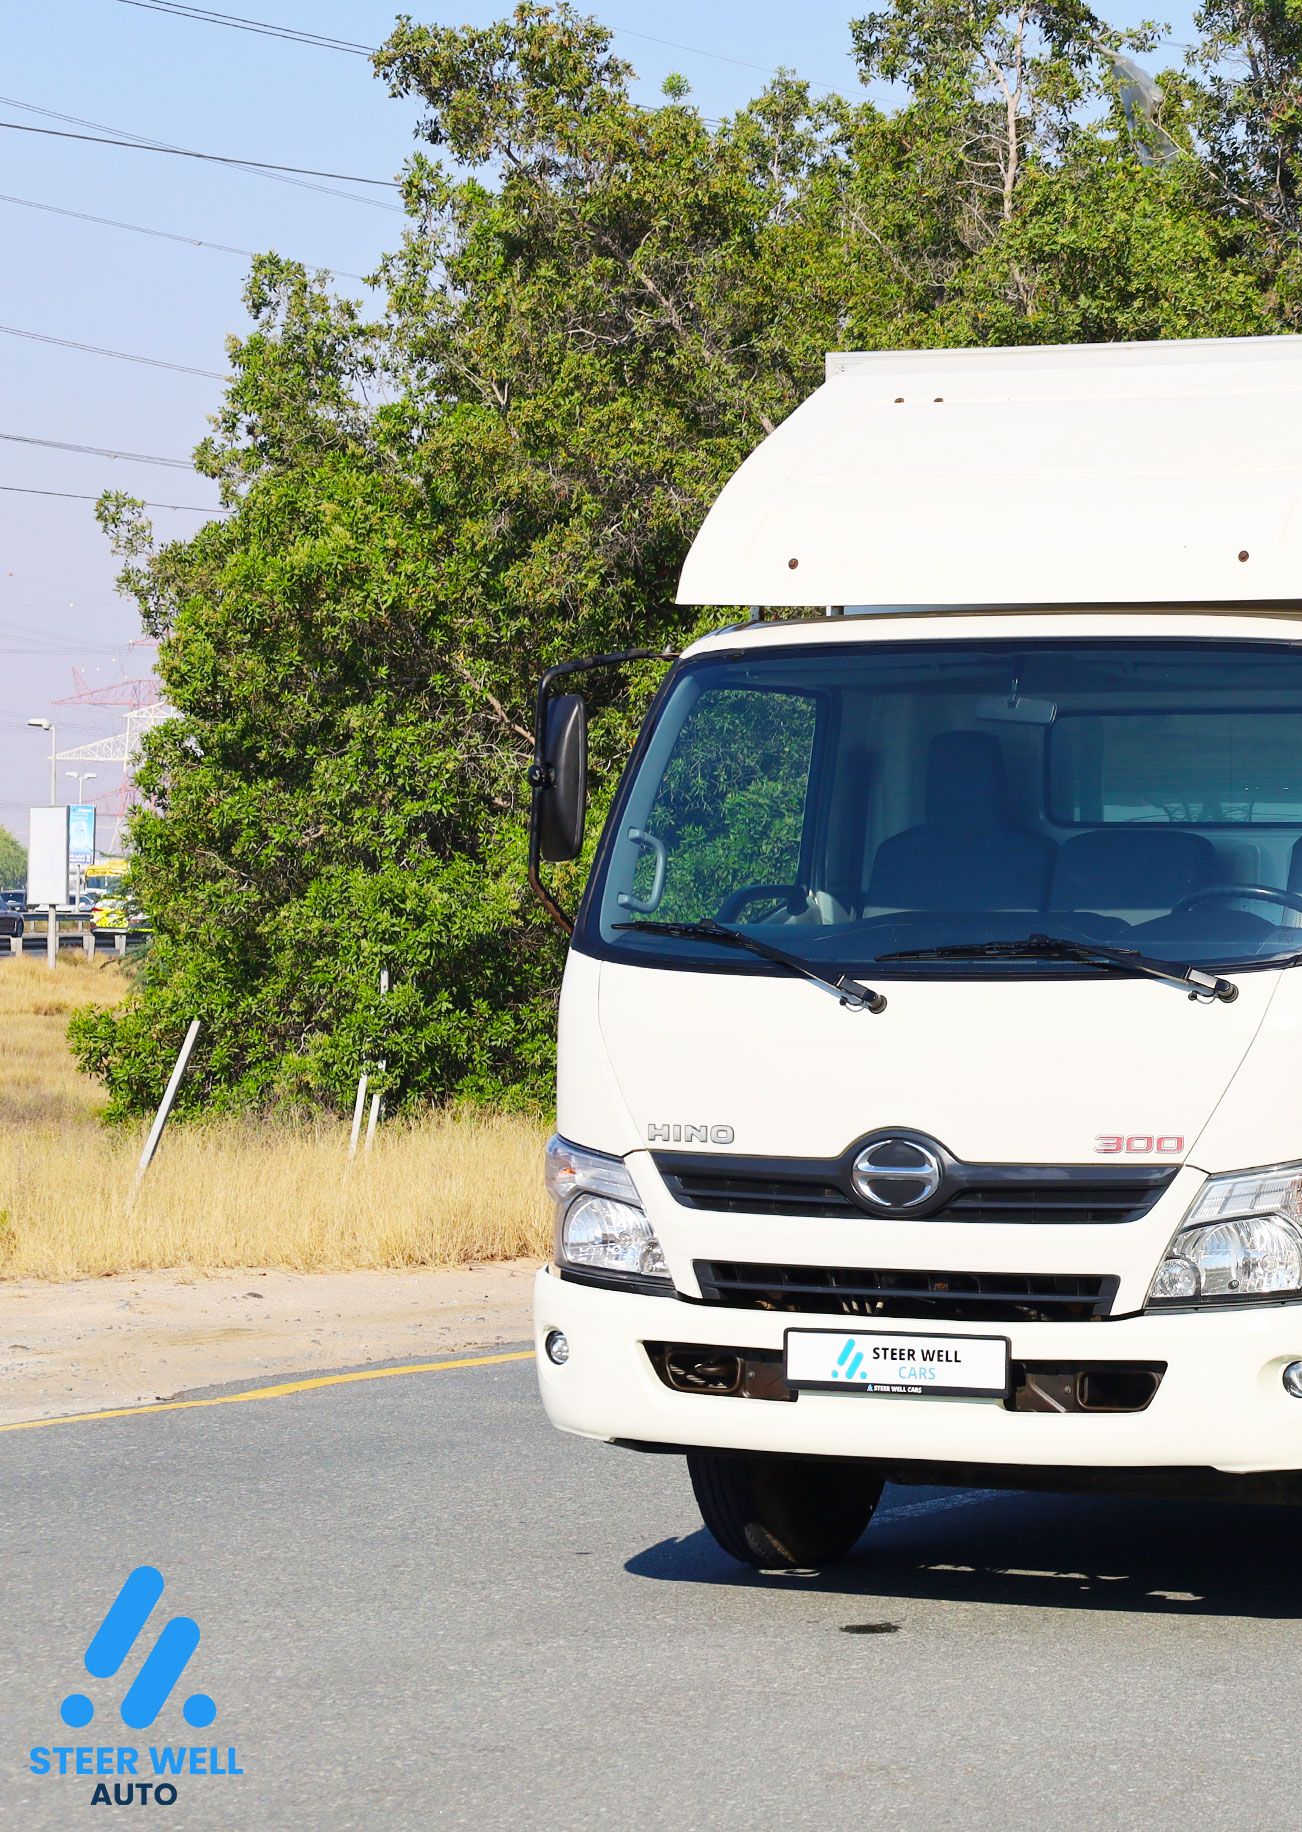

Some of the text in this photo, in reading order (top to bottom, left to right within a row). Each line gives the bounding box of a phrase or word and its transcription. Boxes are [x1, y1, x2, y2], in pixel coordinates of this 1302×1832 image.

[648, 1123, 734, 1144] HINO
[1094, 1135, 1184, 1154] 300
[872, 1347, 962, 1363] STEER WELL
[898, 1366, 936, 1380] CARS
[891, 1385, 907, 1393] WELL
[907, 1386, 922, 1394] CARS
